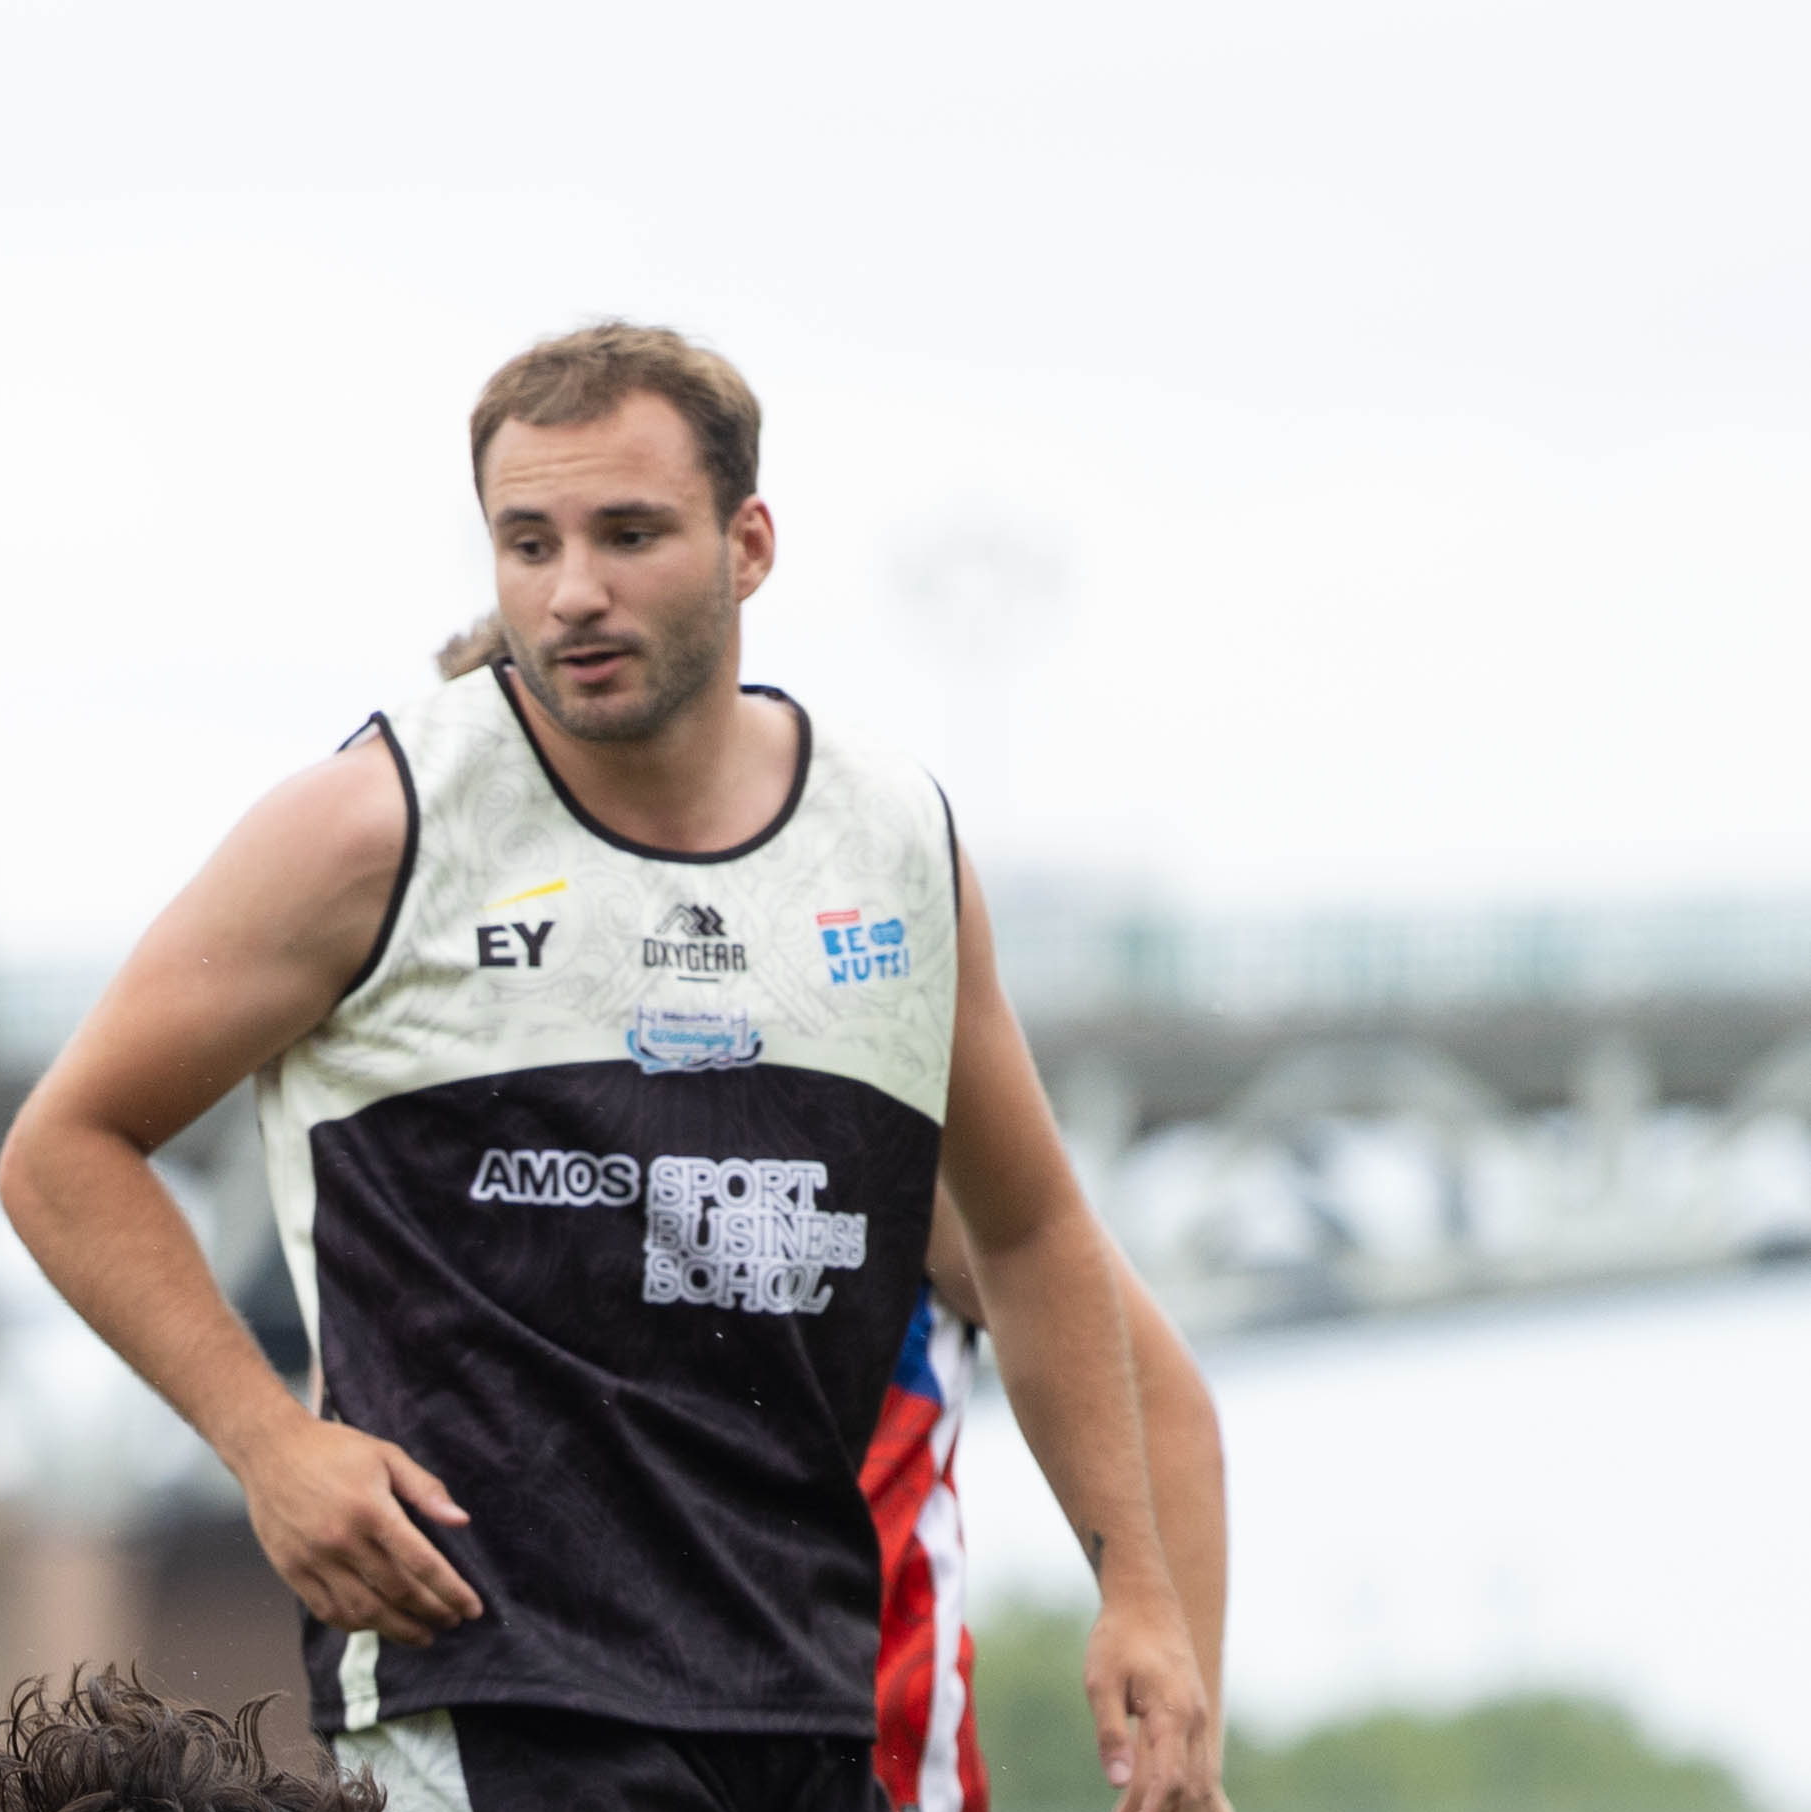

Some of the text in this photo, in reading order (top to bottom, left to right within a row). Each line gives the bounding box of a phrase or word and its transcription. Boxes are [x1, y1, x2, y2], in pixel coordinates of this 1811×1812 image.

[476, 920, 555, 968] EY
[829, 948, 910, 984] NUTS!
[474, 1151, 639, 1204] AMOS
[648, 1156, 827, 1212] SPORT
[645, 1208, 868, 1269] BUSINESS
[643, 1254, 834, 1315] SCHOOL
